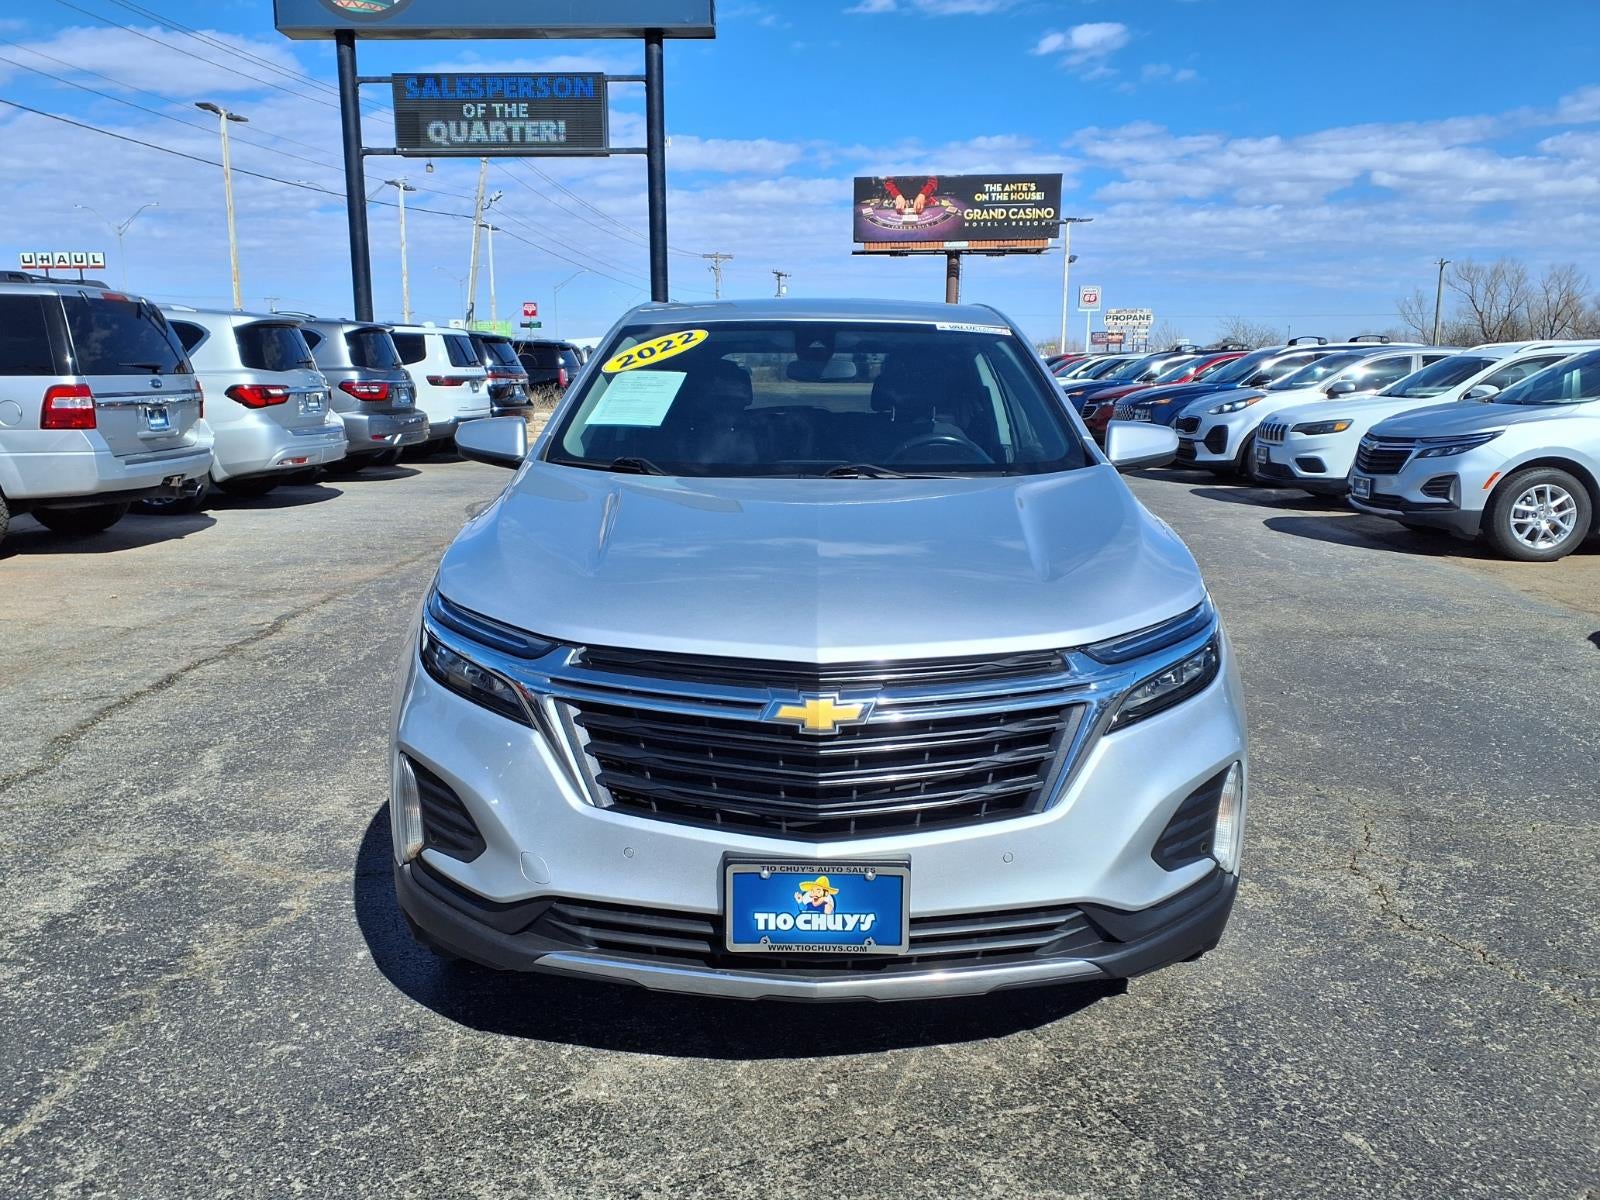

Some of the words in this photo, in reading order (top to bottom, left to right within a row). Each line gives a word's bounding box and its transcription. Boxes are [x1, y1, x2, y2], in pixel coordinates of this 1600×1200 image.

[404, 76, 595, 98] SALESPERSON
[462, 103, 487, 118] OF
[495, 103, 529, 118] THE
[426, 120, 567, 145] QUARTER!
[984, 183, 1002, 192] THE
[1004, 183, 1036, 191] ANTE'S
[974, 193, 989, 201] ON
[991, 193, 1009, 201] THE
[1011, 192, 1045, 200] HOUSE!
[963, 209, 1007, 220] GRAND
[1008, 208, 1054, 219] CASINO
[616, 332, 698, 368] 2022
[768, 944, 868, 952] WWW.TIOCHUYS.COM
